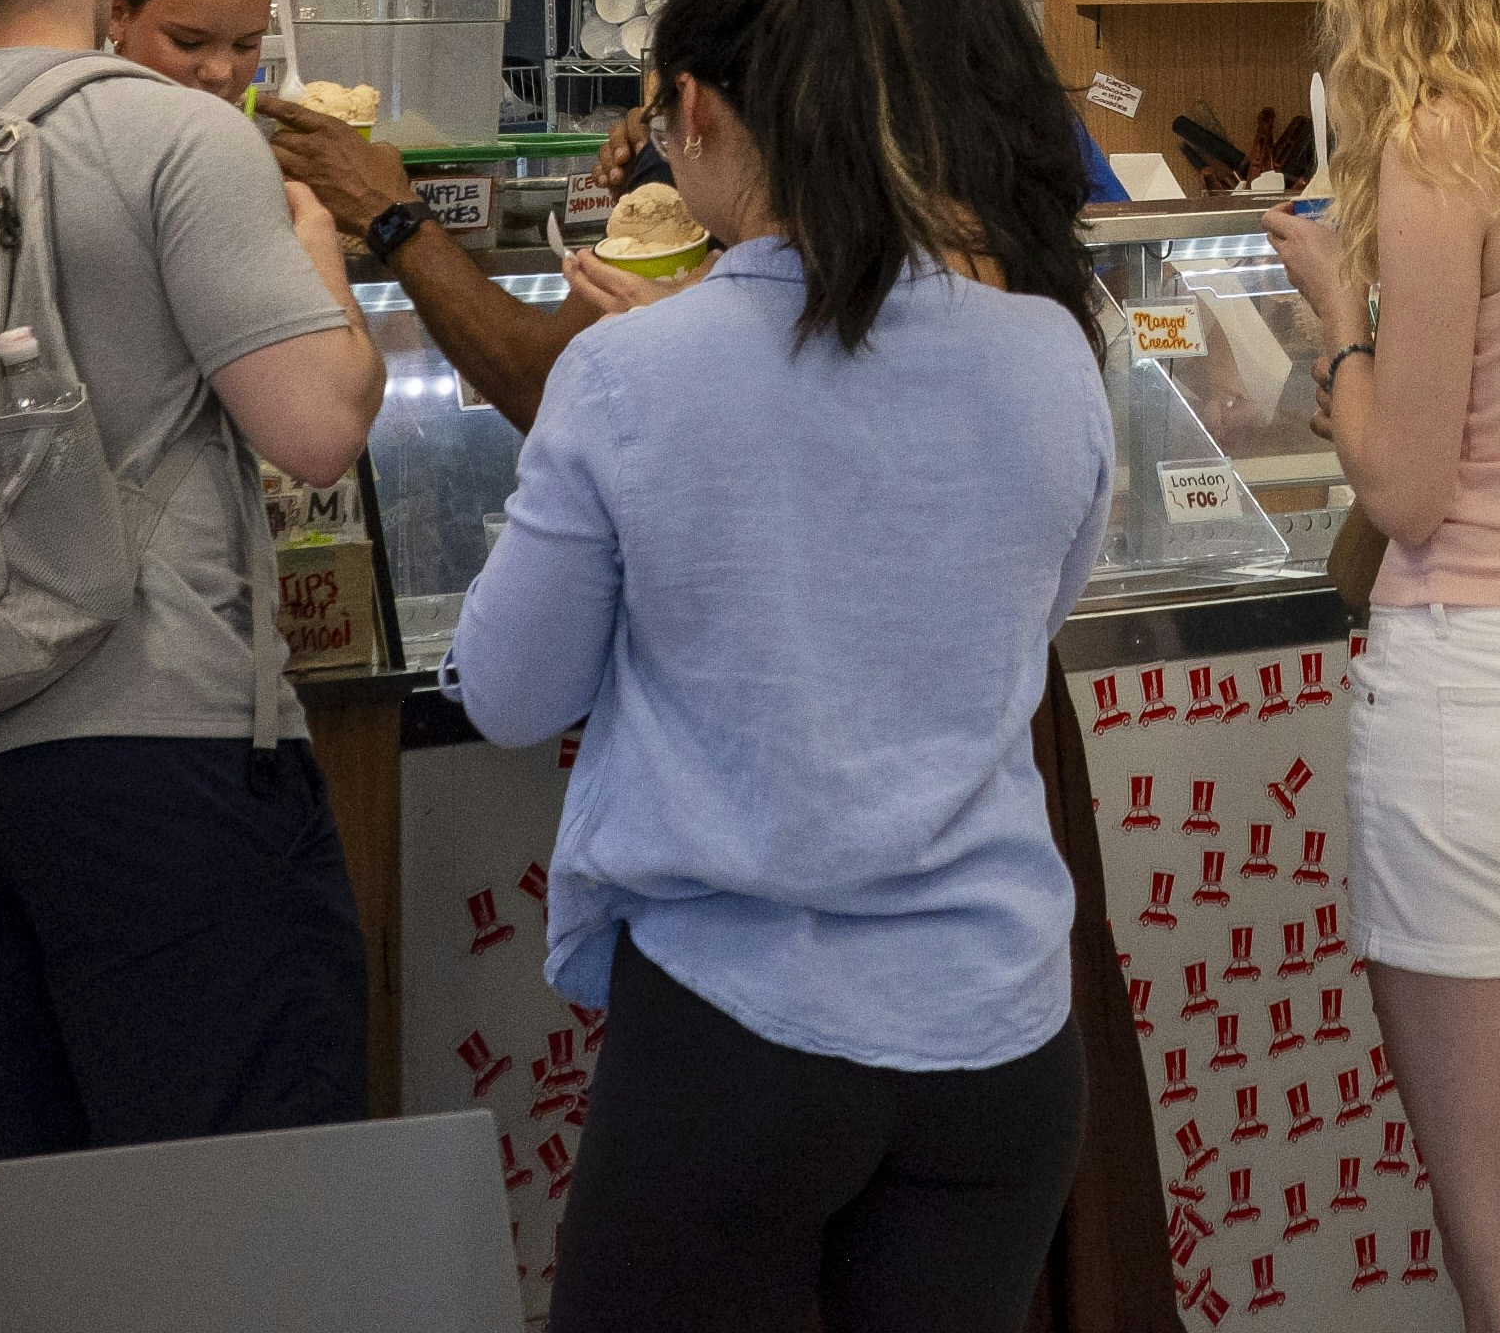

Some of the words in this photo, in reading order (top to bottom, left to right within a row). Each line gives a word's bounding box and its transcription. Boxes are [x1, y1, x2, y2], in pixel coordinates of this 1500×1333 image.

[1134, 312, 1186, 339] Mango
[1139, 333, 1192, 351] Cream
[1171, 473, 1225, 487] London
[1187, 492, 1218, 508] FOG
